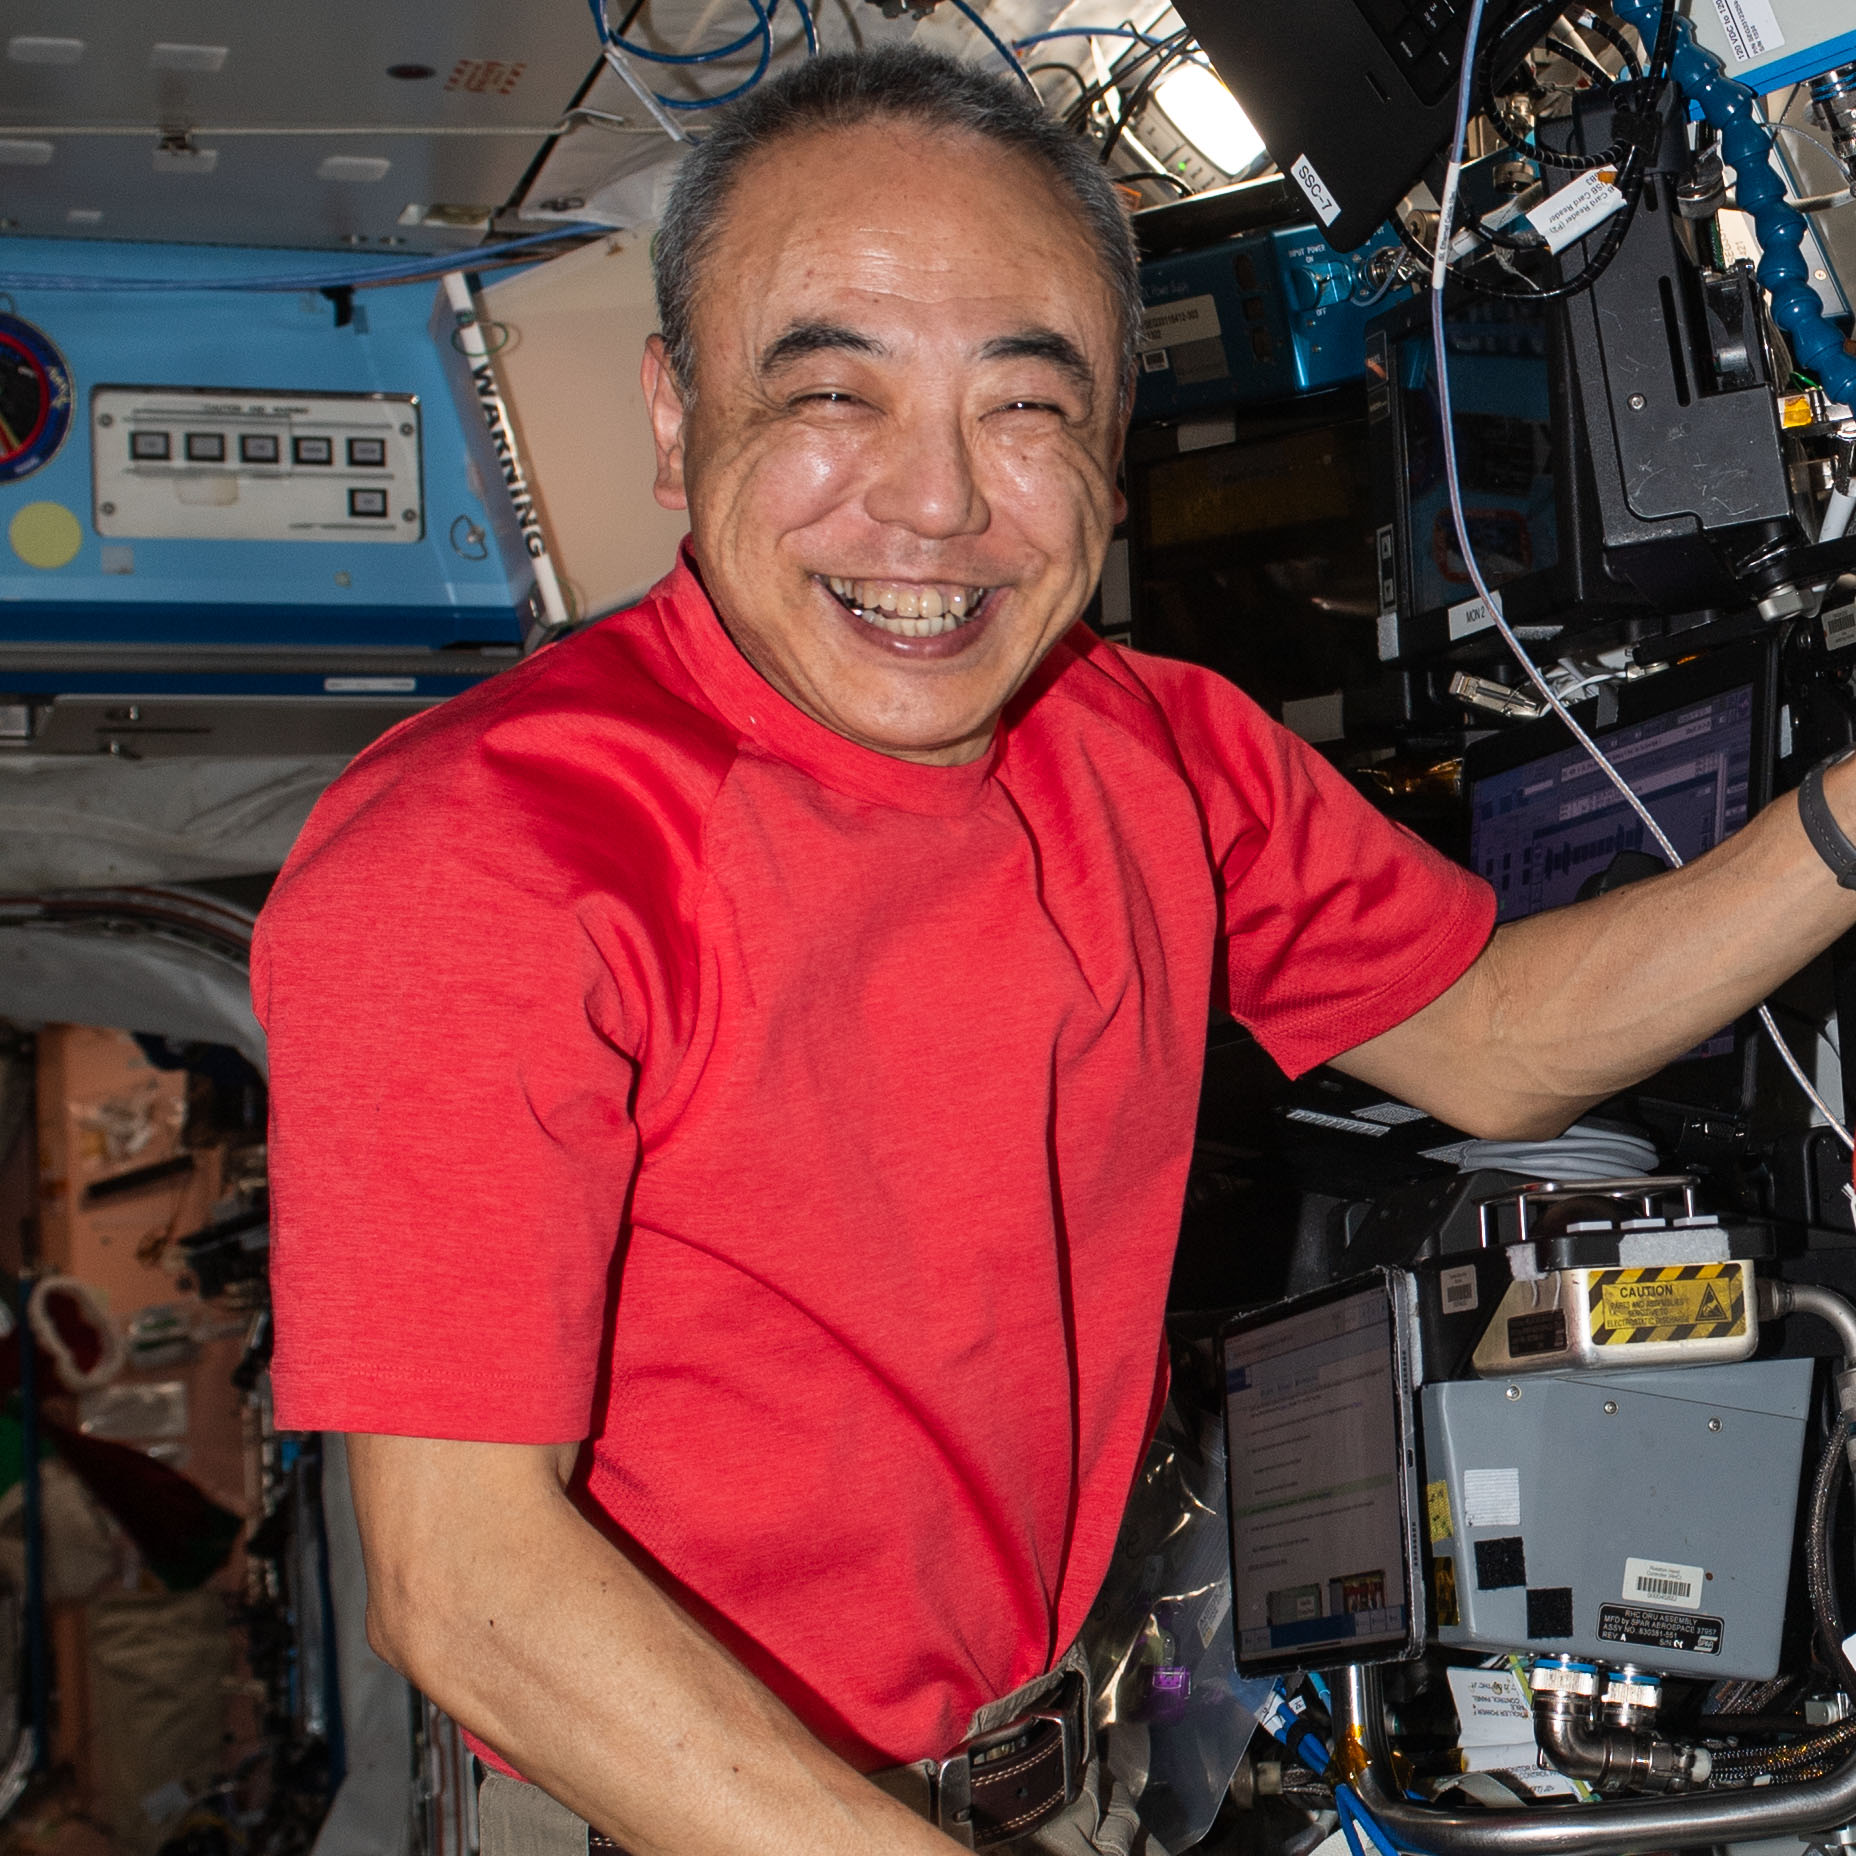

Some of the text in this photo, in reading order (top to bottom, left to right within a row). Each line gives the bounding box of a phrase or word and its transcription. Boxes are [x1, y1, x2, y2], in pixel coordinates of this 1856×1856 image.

[1721, 15, 1731, 25] to
[1724, 25, 1738, 44] VDC
[1732, 45, 1744, 60] 120
[1296, 165, 1332, 210] SSC-7
[467, 362, 551, 560] WARNING
[1619, 1285, 1672, 1297] CAUTION
[1624, 1609, 1697, 1625] RHC ORU ASSEMBLY
